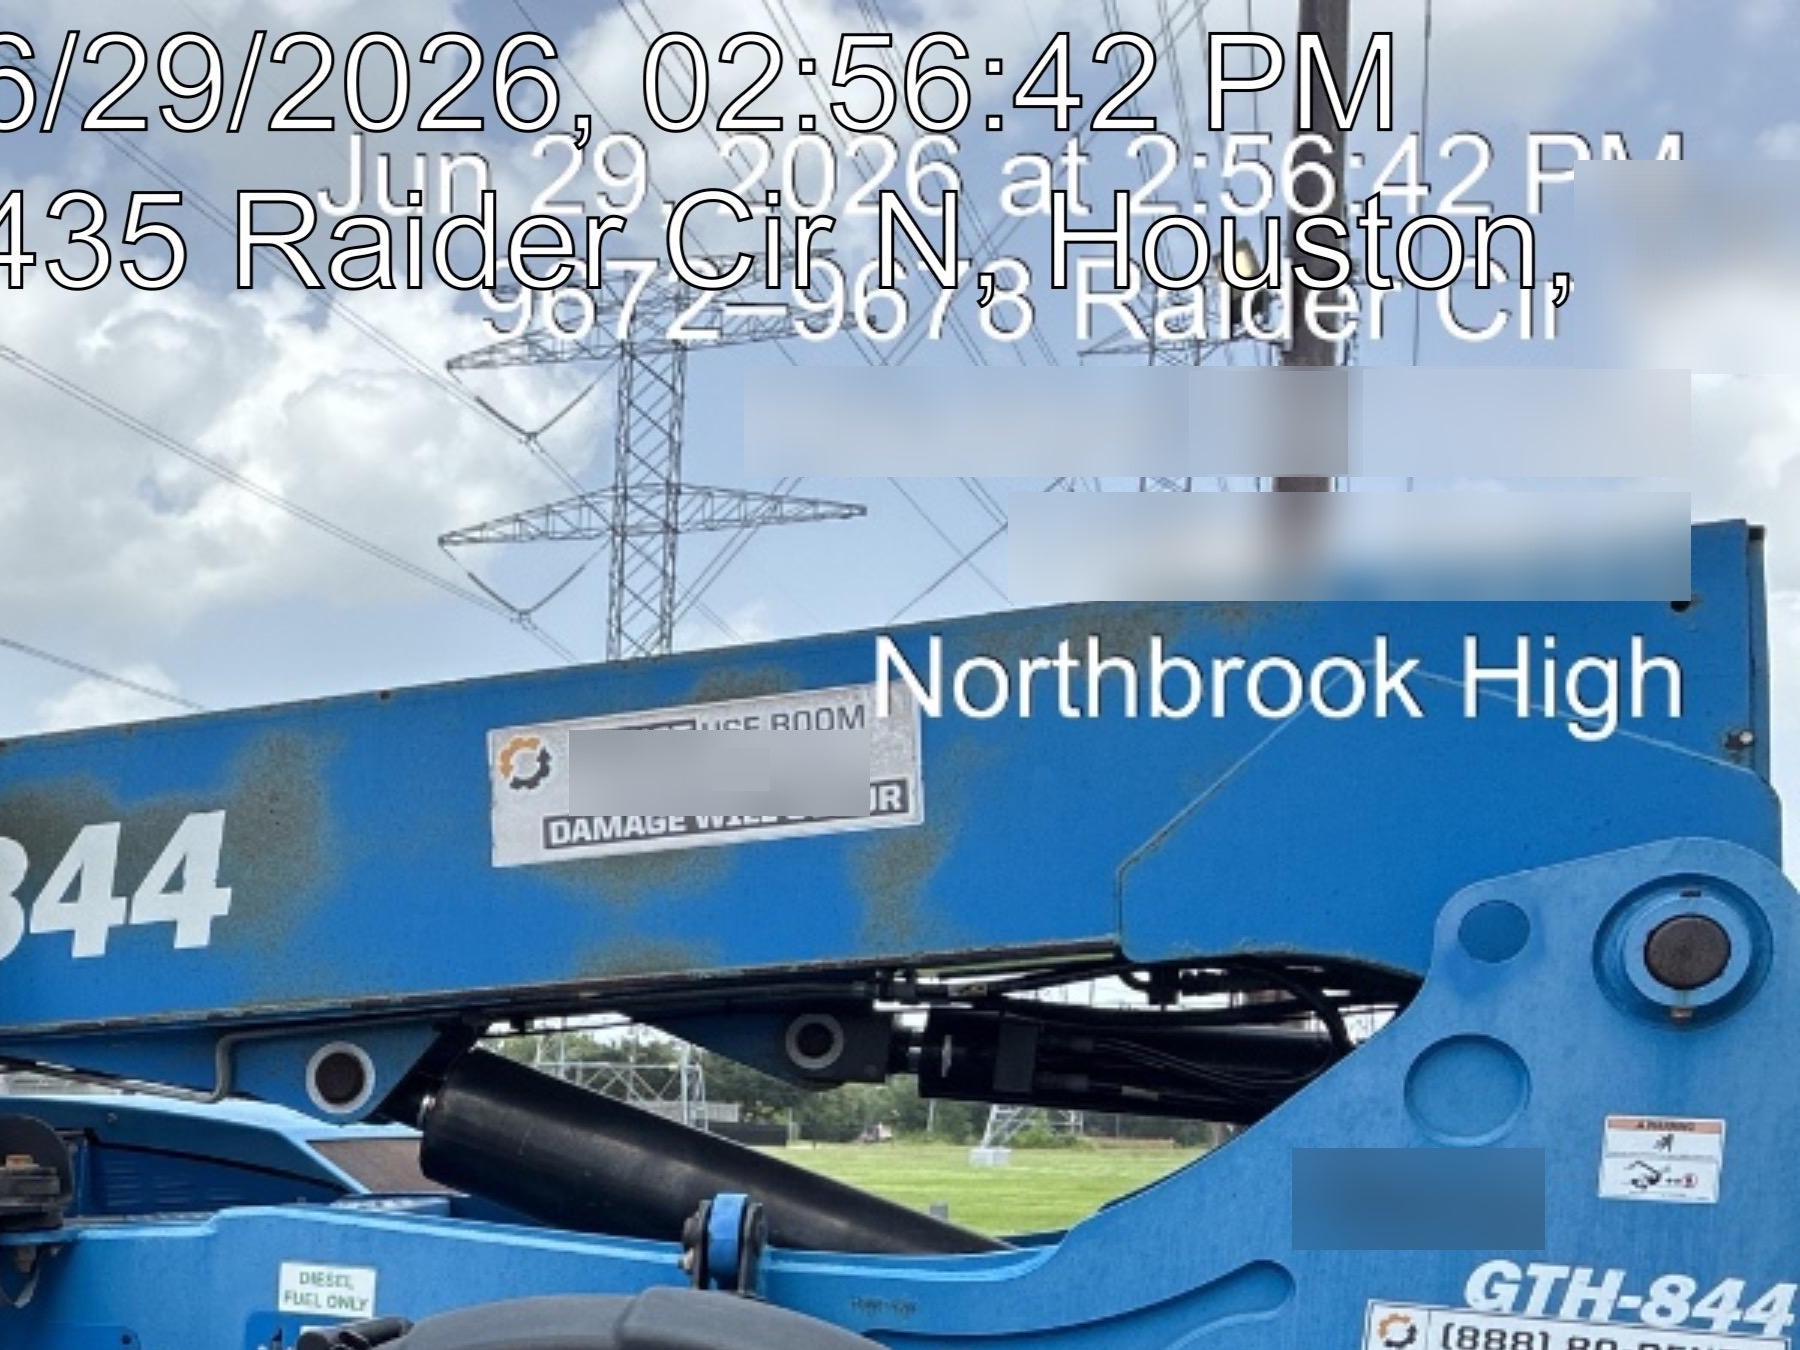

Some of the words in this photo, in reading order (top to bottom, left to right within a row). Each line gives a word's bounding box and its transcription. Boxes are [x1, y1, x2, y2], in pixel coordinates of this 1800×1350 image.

[551, 815, 687, 848] DAMAGE
[299, 1271, 354, 1290] DIESEL
[284, 1290, 321, 1308] FUEL
[327, 1295, 369, 1312] ONLY
[1464, 1259, 1797, 1337] GTH-844
